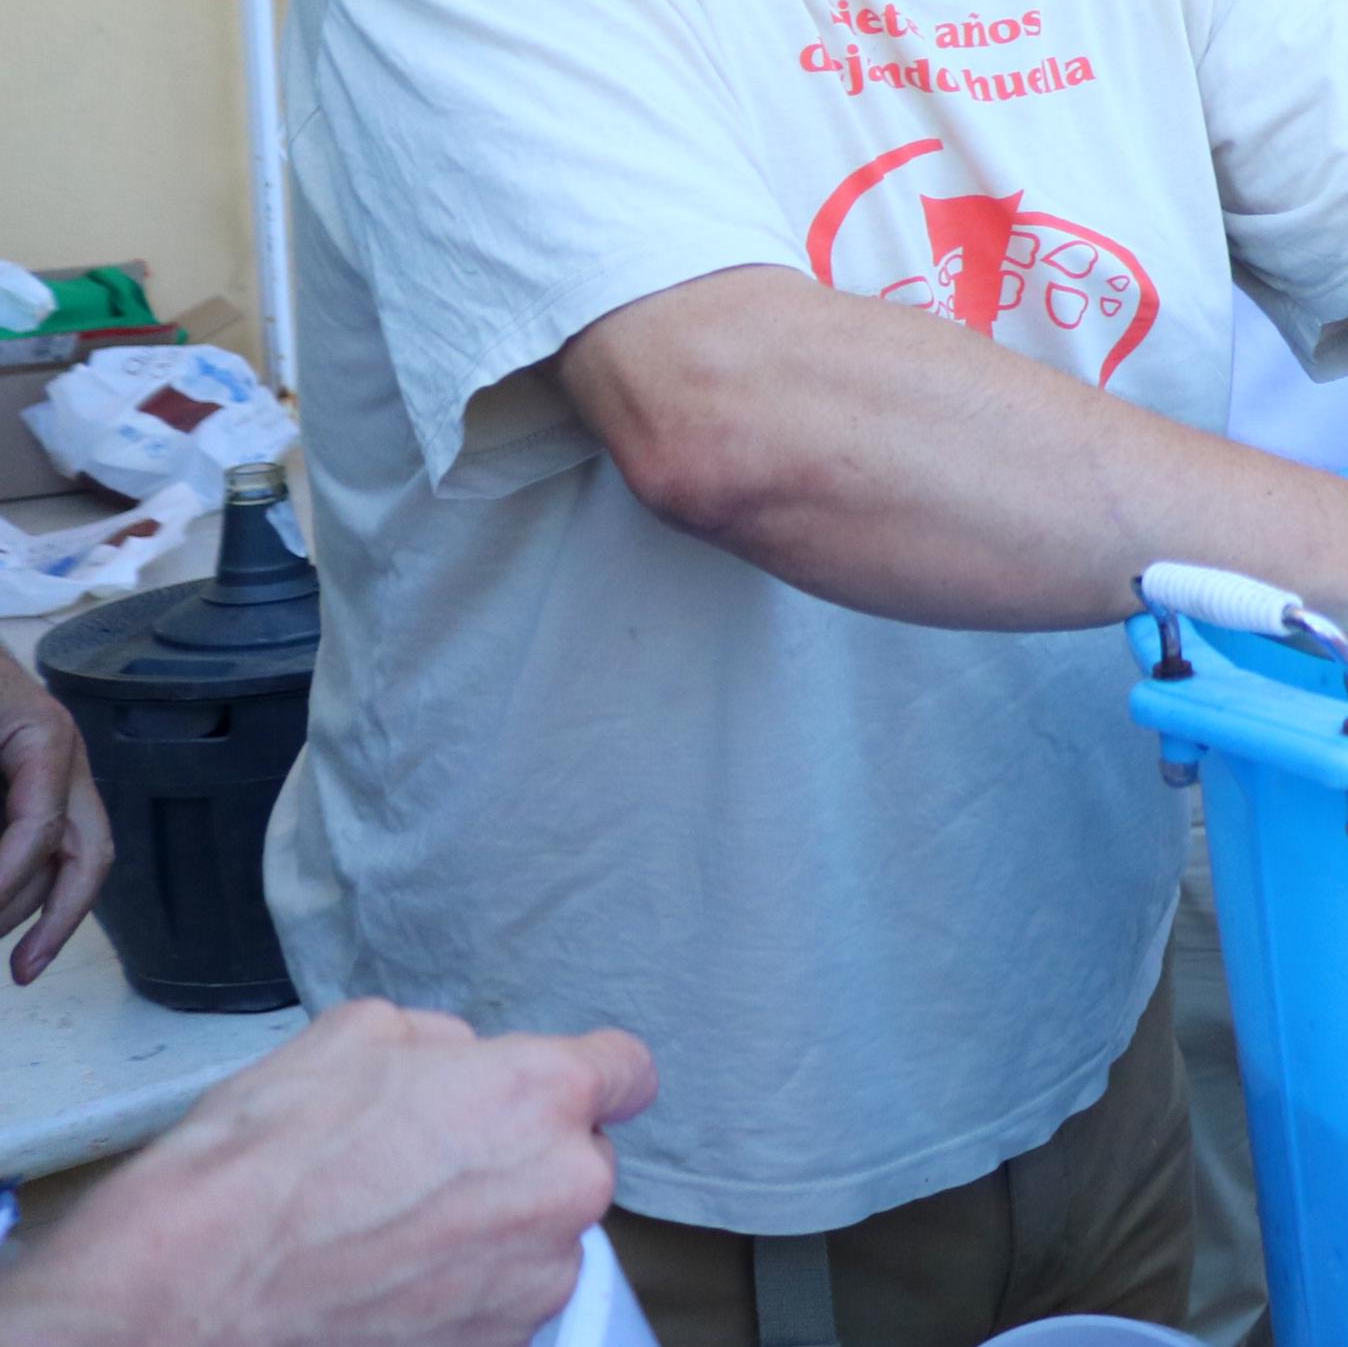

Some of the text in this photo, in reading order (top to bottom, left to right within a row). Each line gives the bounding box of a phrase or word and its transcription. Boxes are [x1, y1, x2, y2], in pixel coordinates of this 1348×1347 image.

[934, 11, 1041, 49] años
[799, 36, 1096, 103] djando huella
